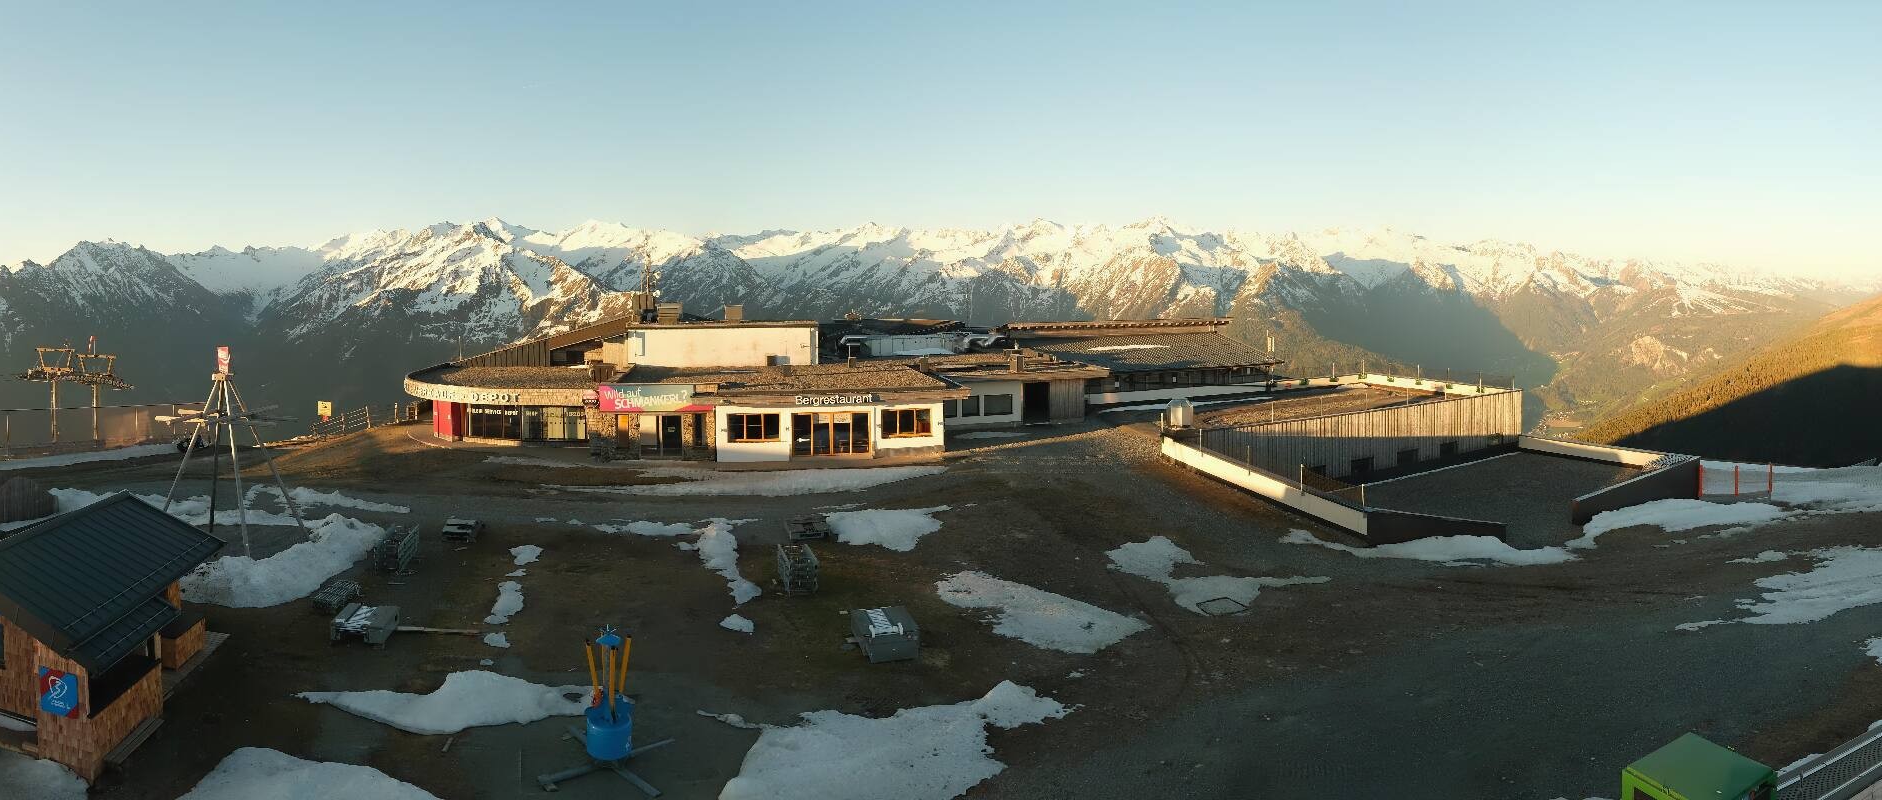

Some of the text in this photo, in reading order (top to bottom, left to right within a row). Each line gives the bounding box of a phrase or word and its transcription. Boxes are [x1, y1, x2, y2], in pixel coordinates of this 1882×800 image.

[471, 393, 521, 403] DEPOT
[604, 386, 624, 400] Wild
[626, 386, 642, 398] auf
[795, 393, 873, 407] Bergrestaurant
